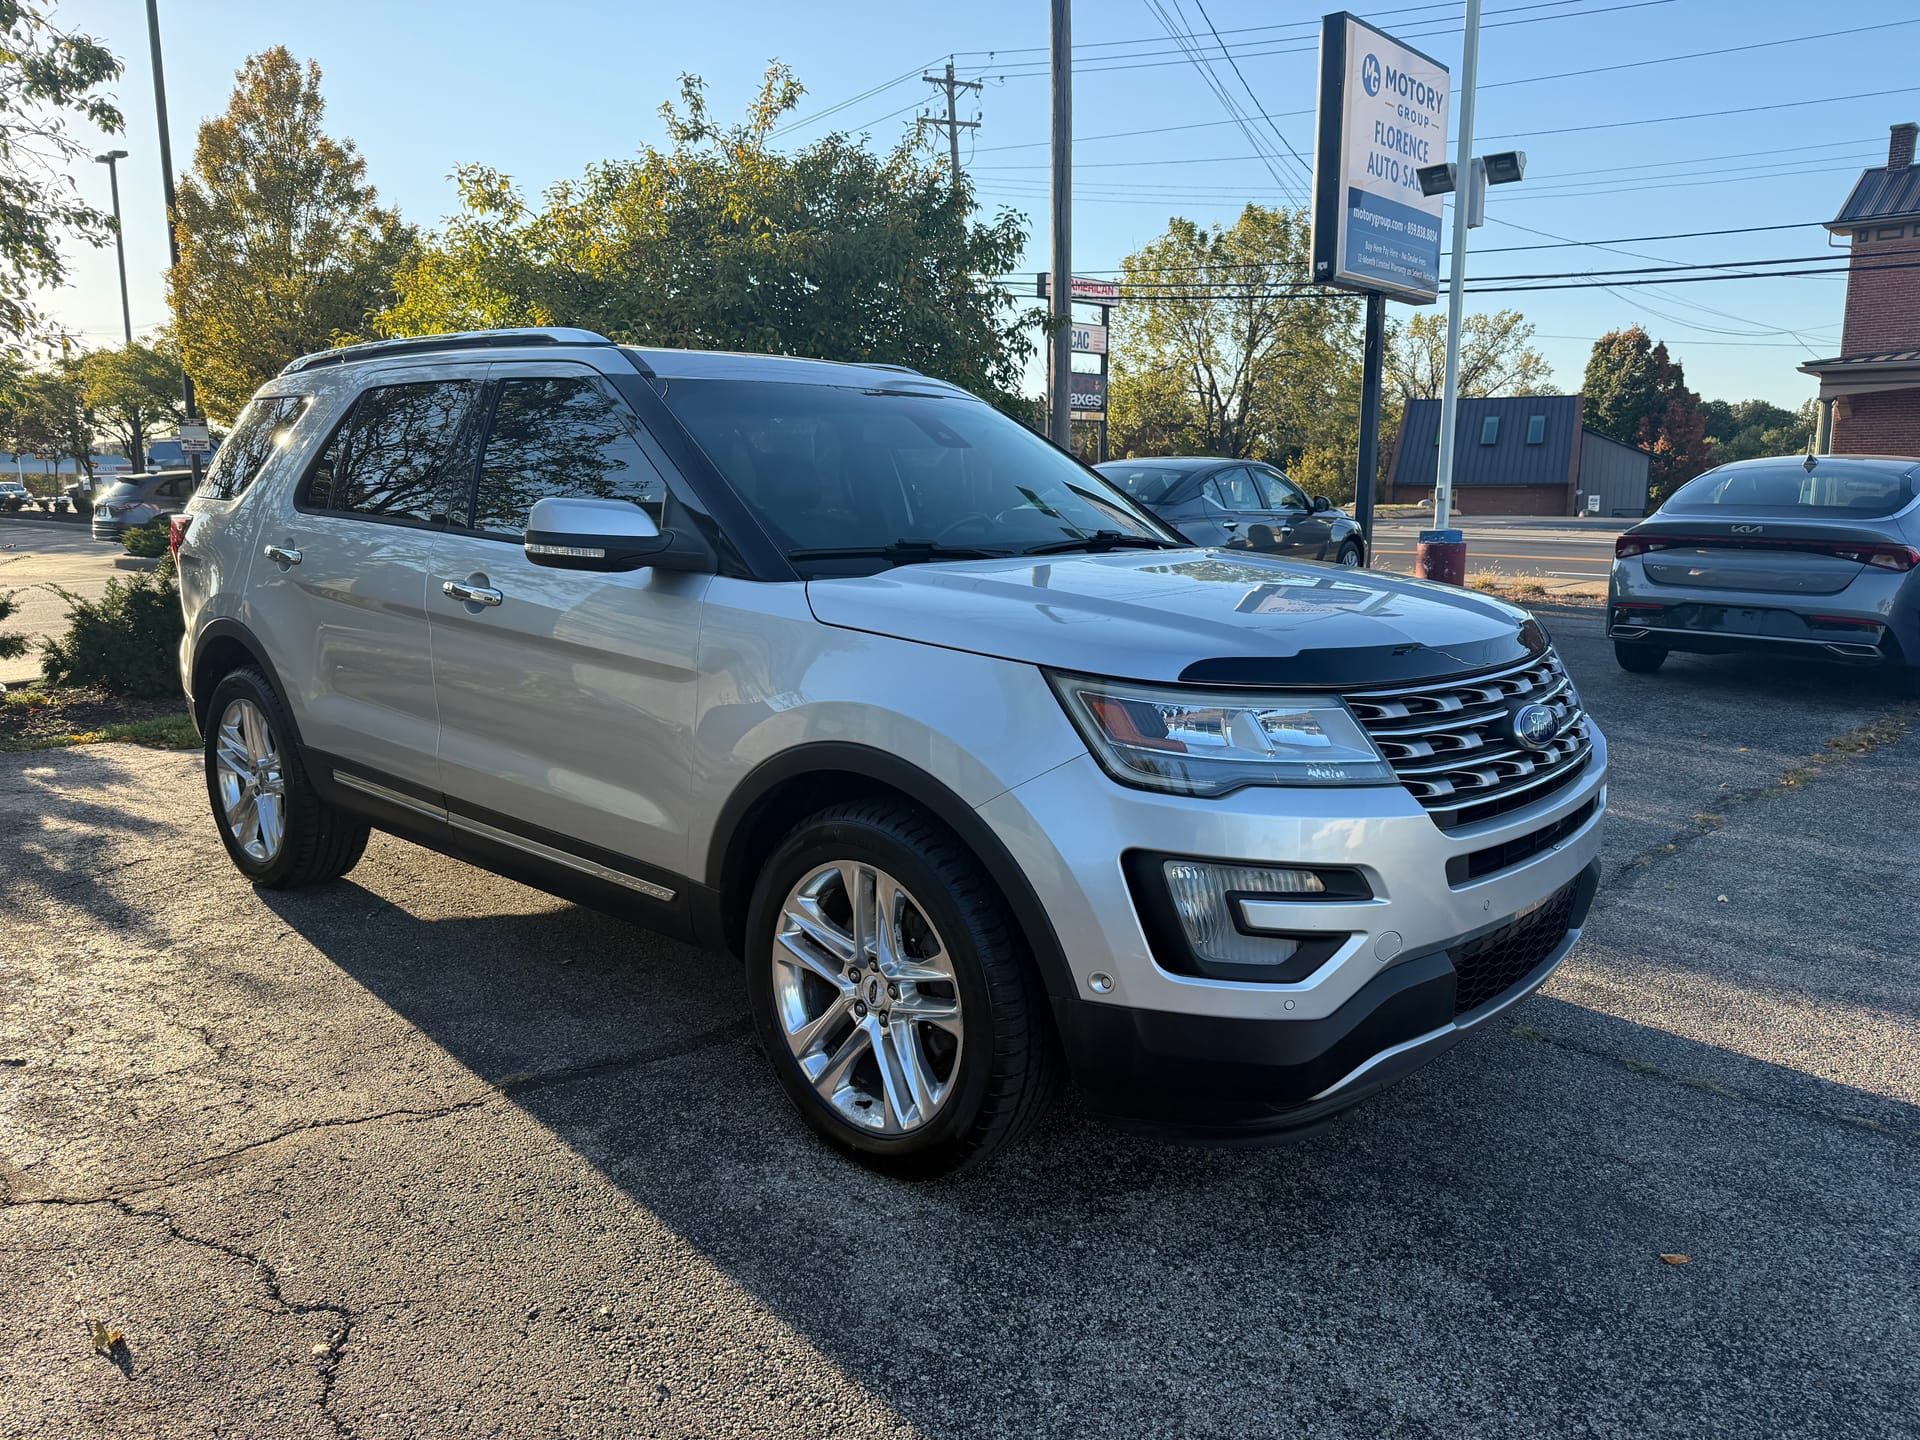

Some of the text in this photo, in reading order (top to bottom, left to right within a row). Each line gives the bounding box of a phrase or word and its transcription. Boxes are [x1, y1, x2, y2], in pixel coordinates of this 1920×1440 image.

[1385, 65, 1444, 114] MOTORY
[1397, 104, 1429, 128] GROUP
[1374, 120, 1429, 163] FLORENCE
[1367, 151, 1399, 183] AUTO
[1353, 207, 1404, 232] motorygroup.com
[1070, 392, 1102, 406] axes
[1531, 712, 1554, 737] Ford
